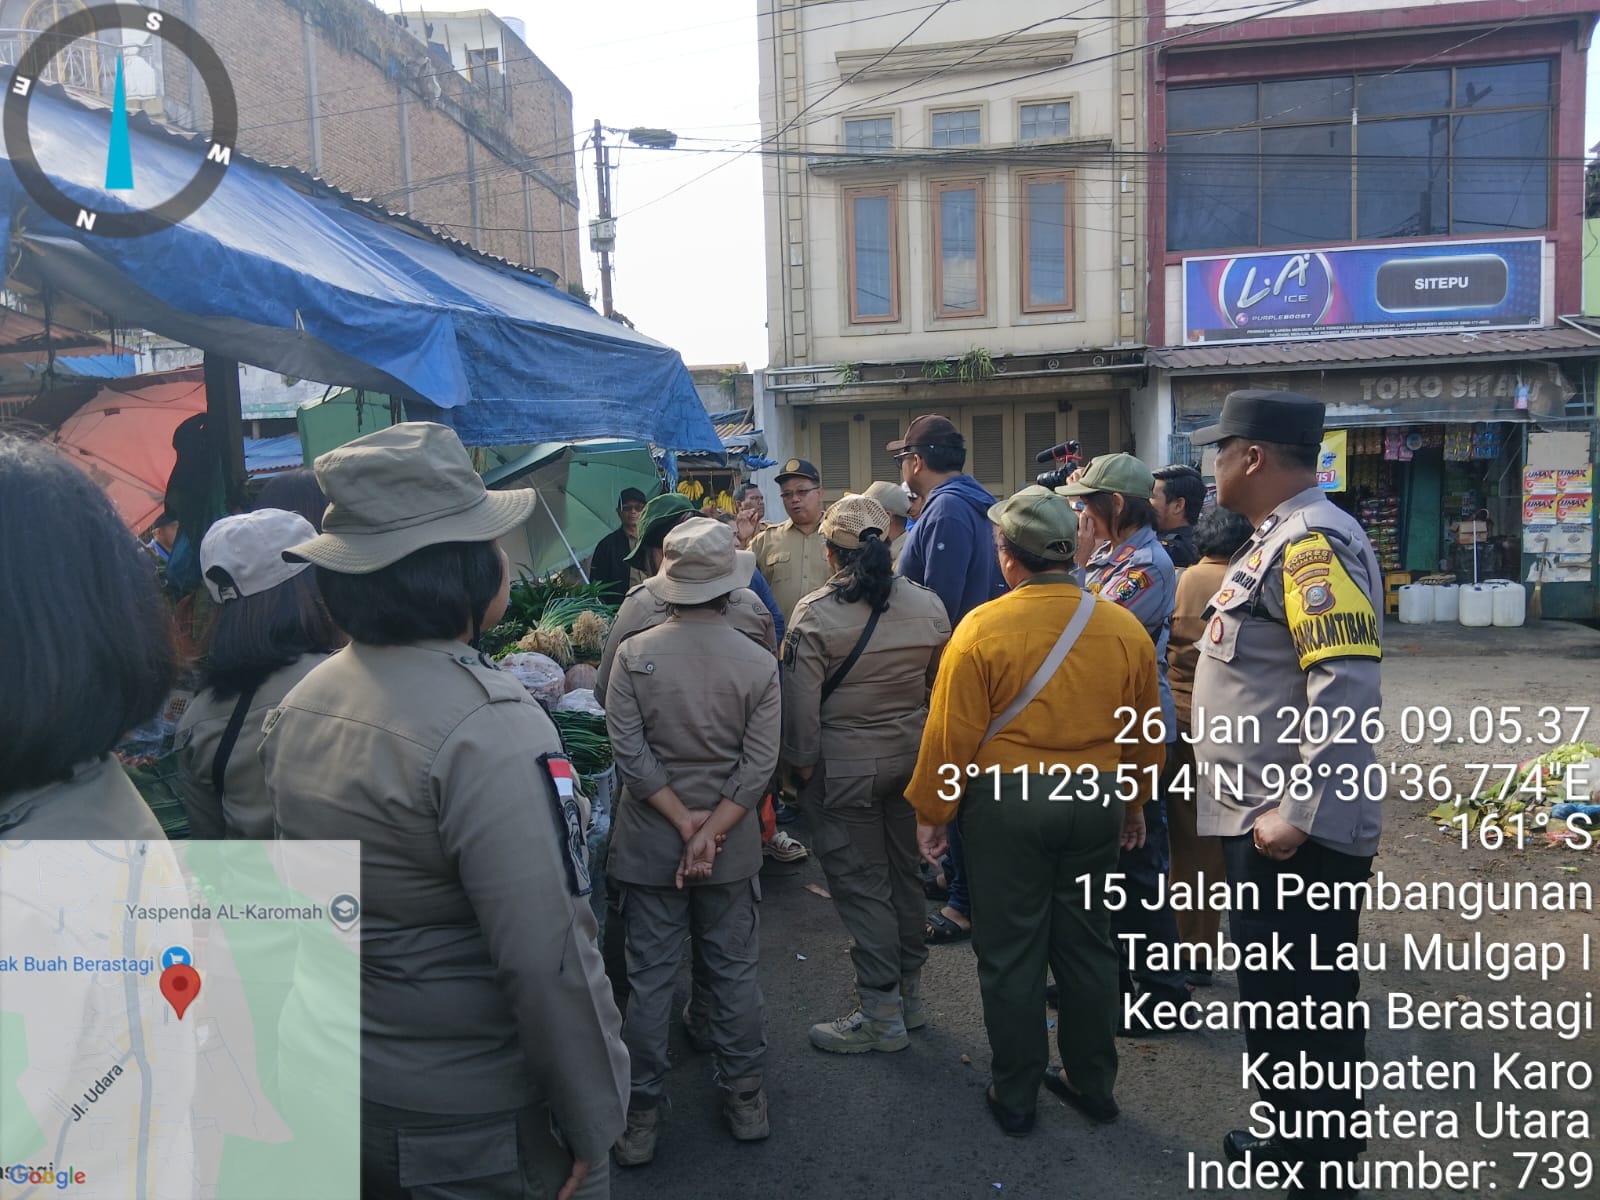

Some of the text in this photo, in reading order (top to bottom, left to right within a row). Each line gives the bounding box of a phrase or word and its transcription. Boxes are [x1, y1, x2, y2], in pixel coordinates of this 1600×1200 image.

[1414, 276, 1469, 290] SITEPU
[1284, 294, 1309, 303] ICE
[1359, 376, 1443, 400] TOKO
[1231, 570, 1257, 590] POLRI
